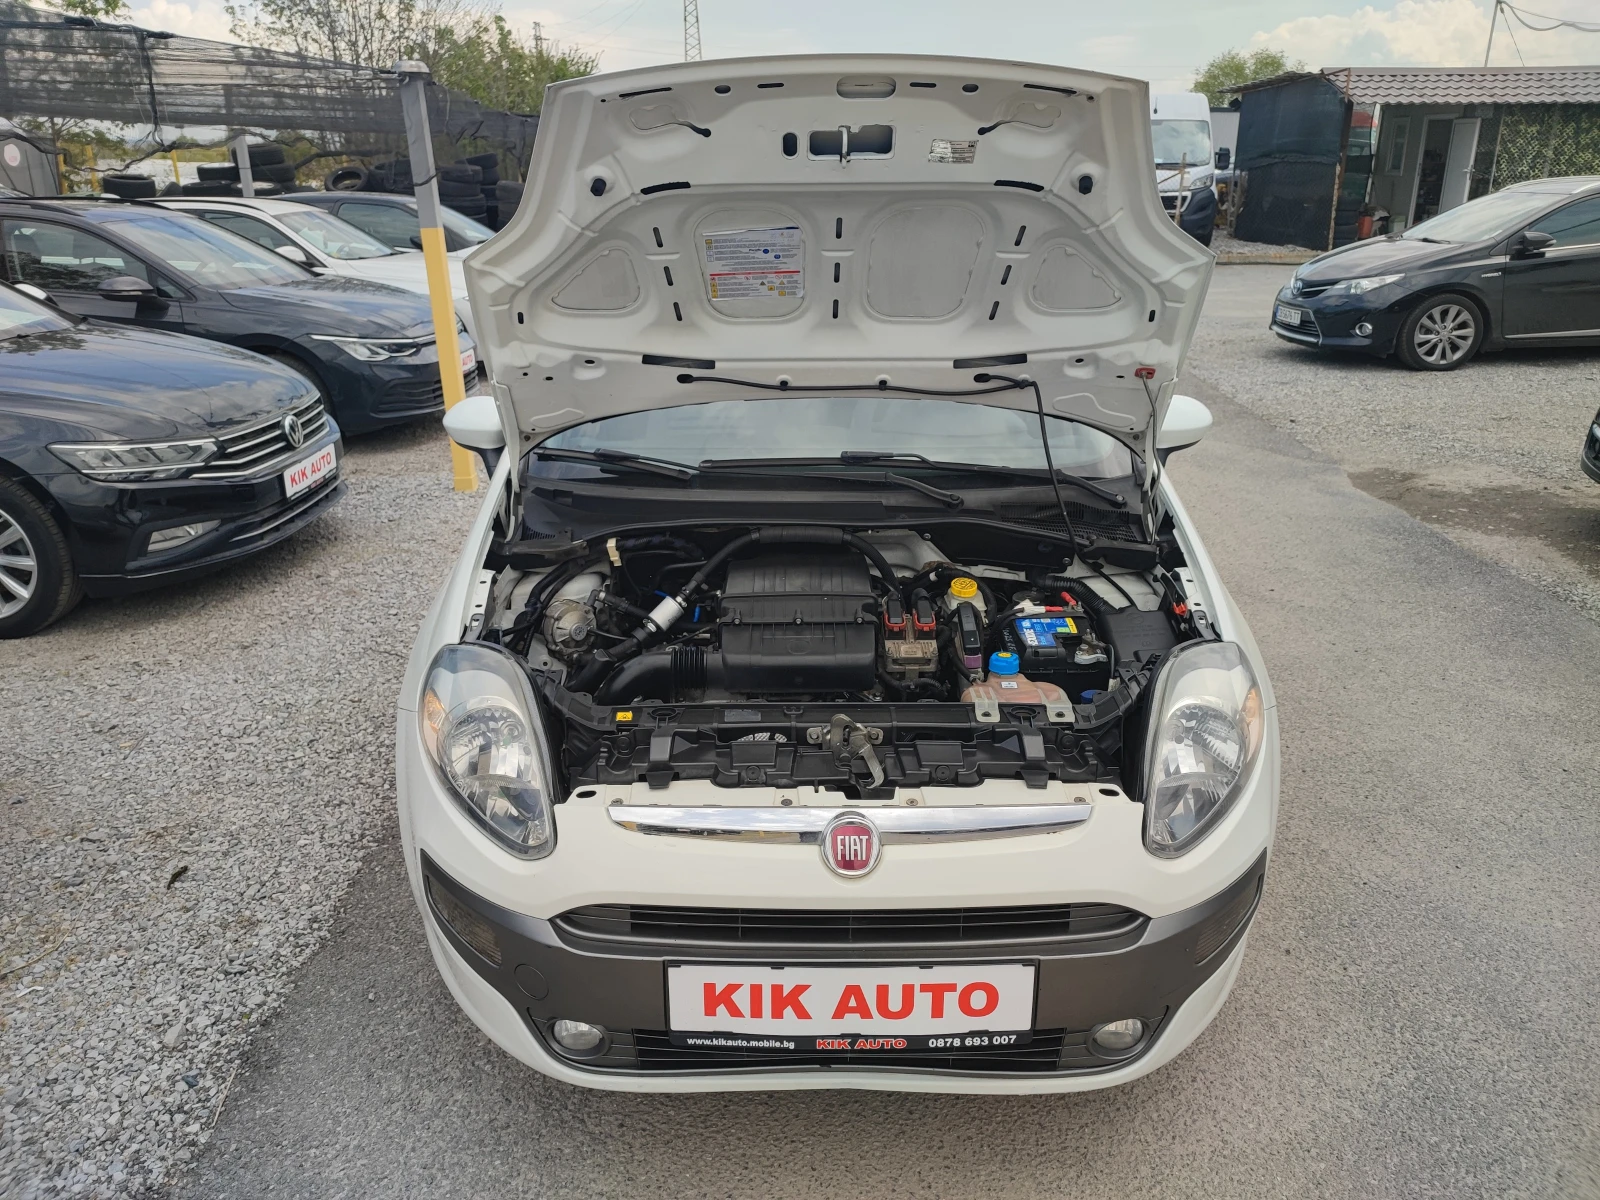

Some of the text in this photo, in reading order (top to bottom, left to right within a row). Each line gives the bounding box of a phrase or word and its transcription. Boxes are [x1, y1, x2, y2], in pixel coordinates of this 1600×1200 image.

[290, 466, 308, 488] KIK
[311, 452, 332, 477] AUTO
[837, 835, 869, 861] FIAT
[703, 981, 1000, 1020] KIK AUTO
[687, 1035, 1017, 1049] www.kikauto.mobile.bg KIK AUTO 0878 693 007
